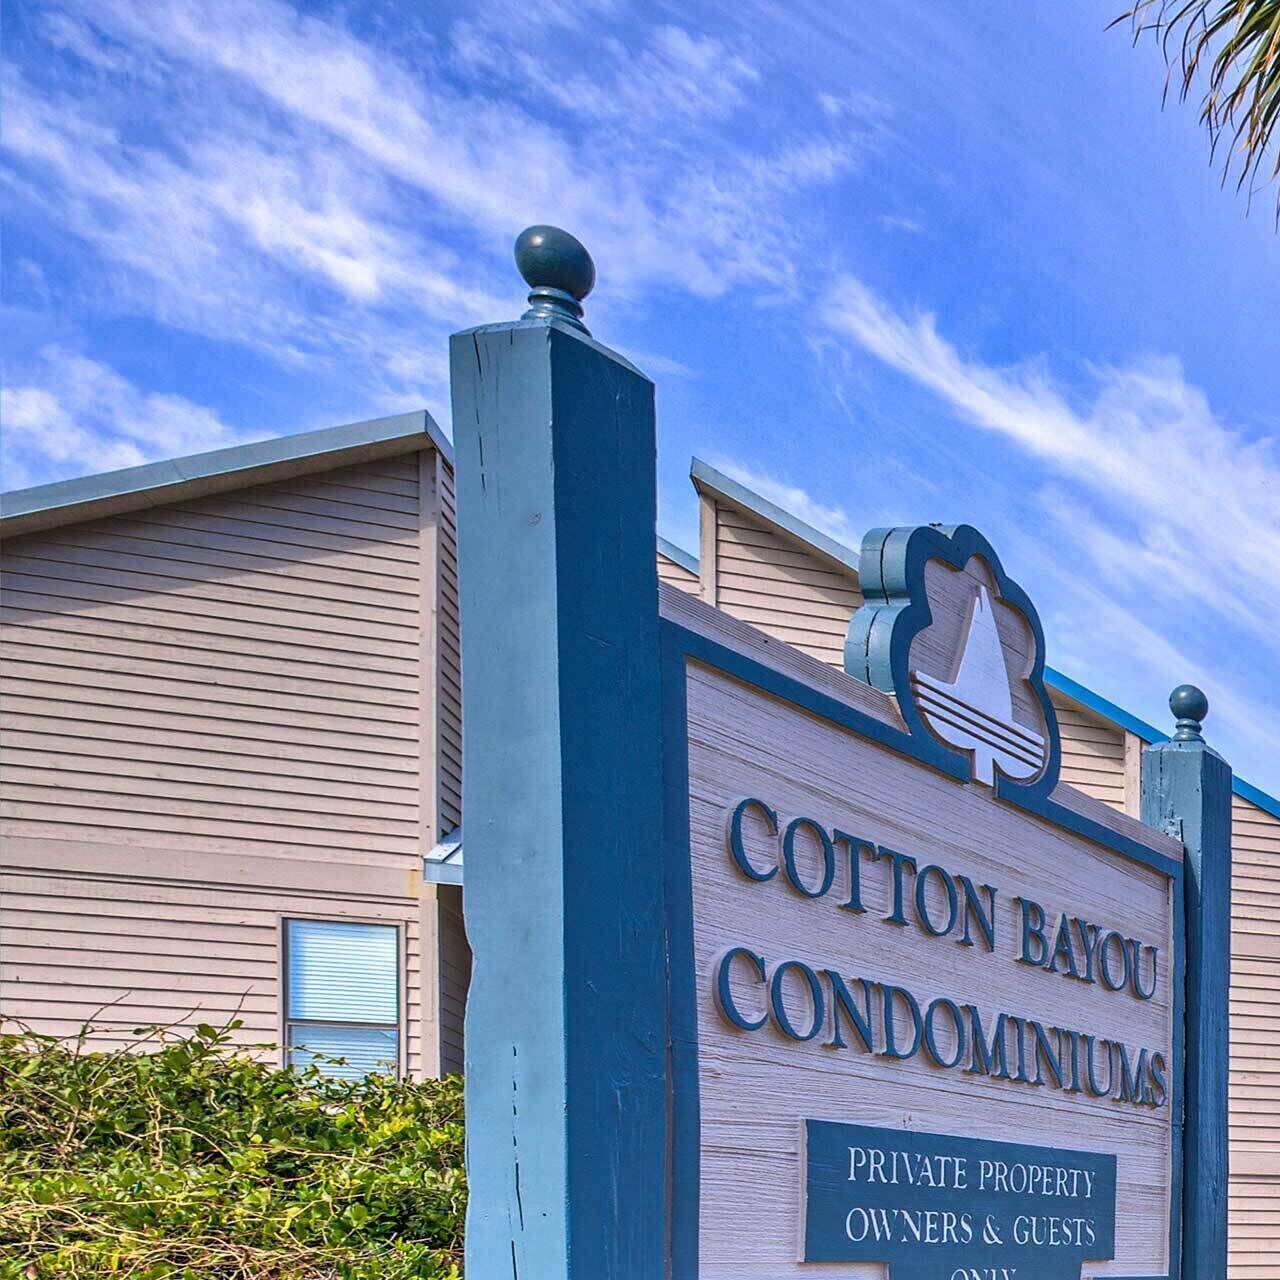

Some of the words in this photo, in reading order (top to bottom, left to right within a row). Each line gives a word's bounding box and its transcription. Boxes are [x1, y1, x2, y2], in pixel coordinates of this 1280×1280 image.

[729, 798, 998, 953] COTTON
[1013, 896, 1158, 1000] BAYOU
[714, 947, 1168, 1107] CONDOMINIUMS
[848, 1147, 967, 1189] PRIVATE
[979, 1160, 1096, 1198] PROPERTY
[846, 1208, 973, 1244] OWNERS
[982, 1215, 1003, 1245] &
[1013, 1215, 1096, 1247] GUESTS
